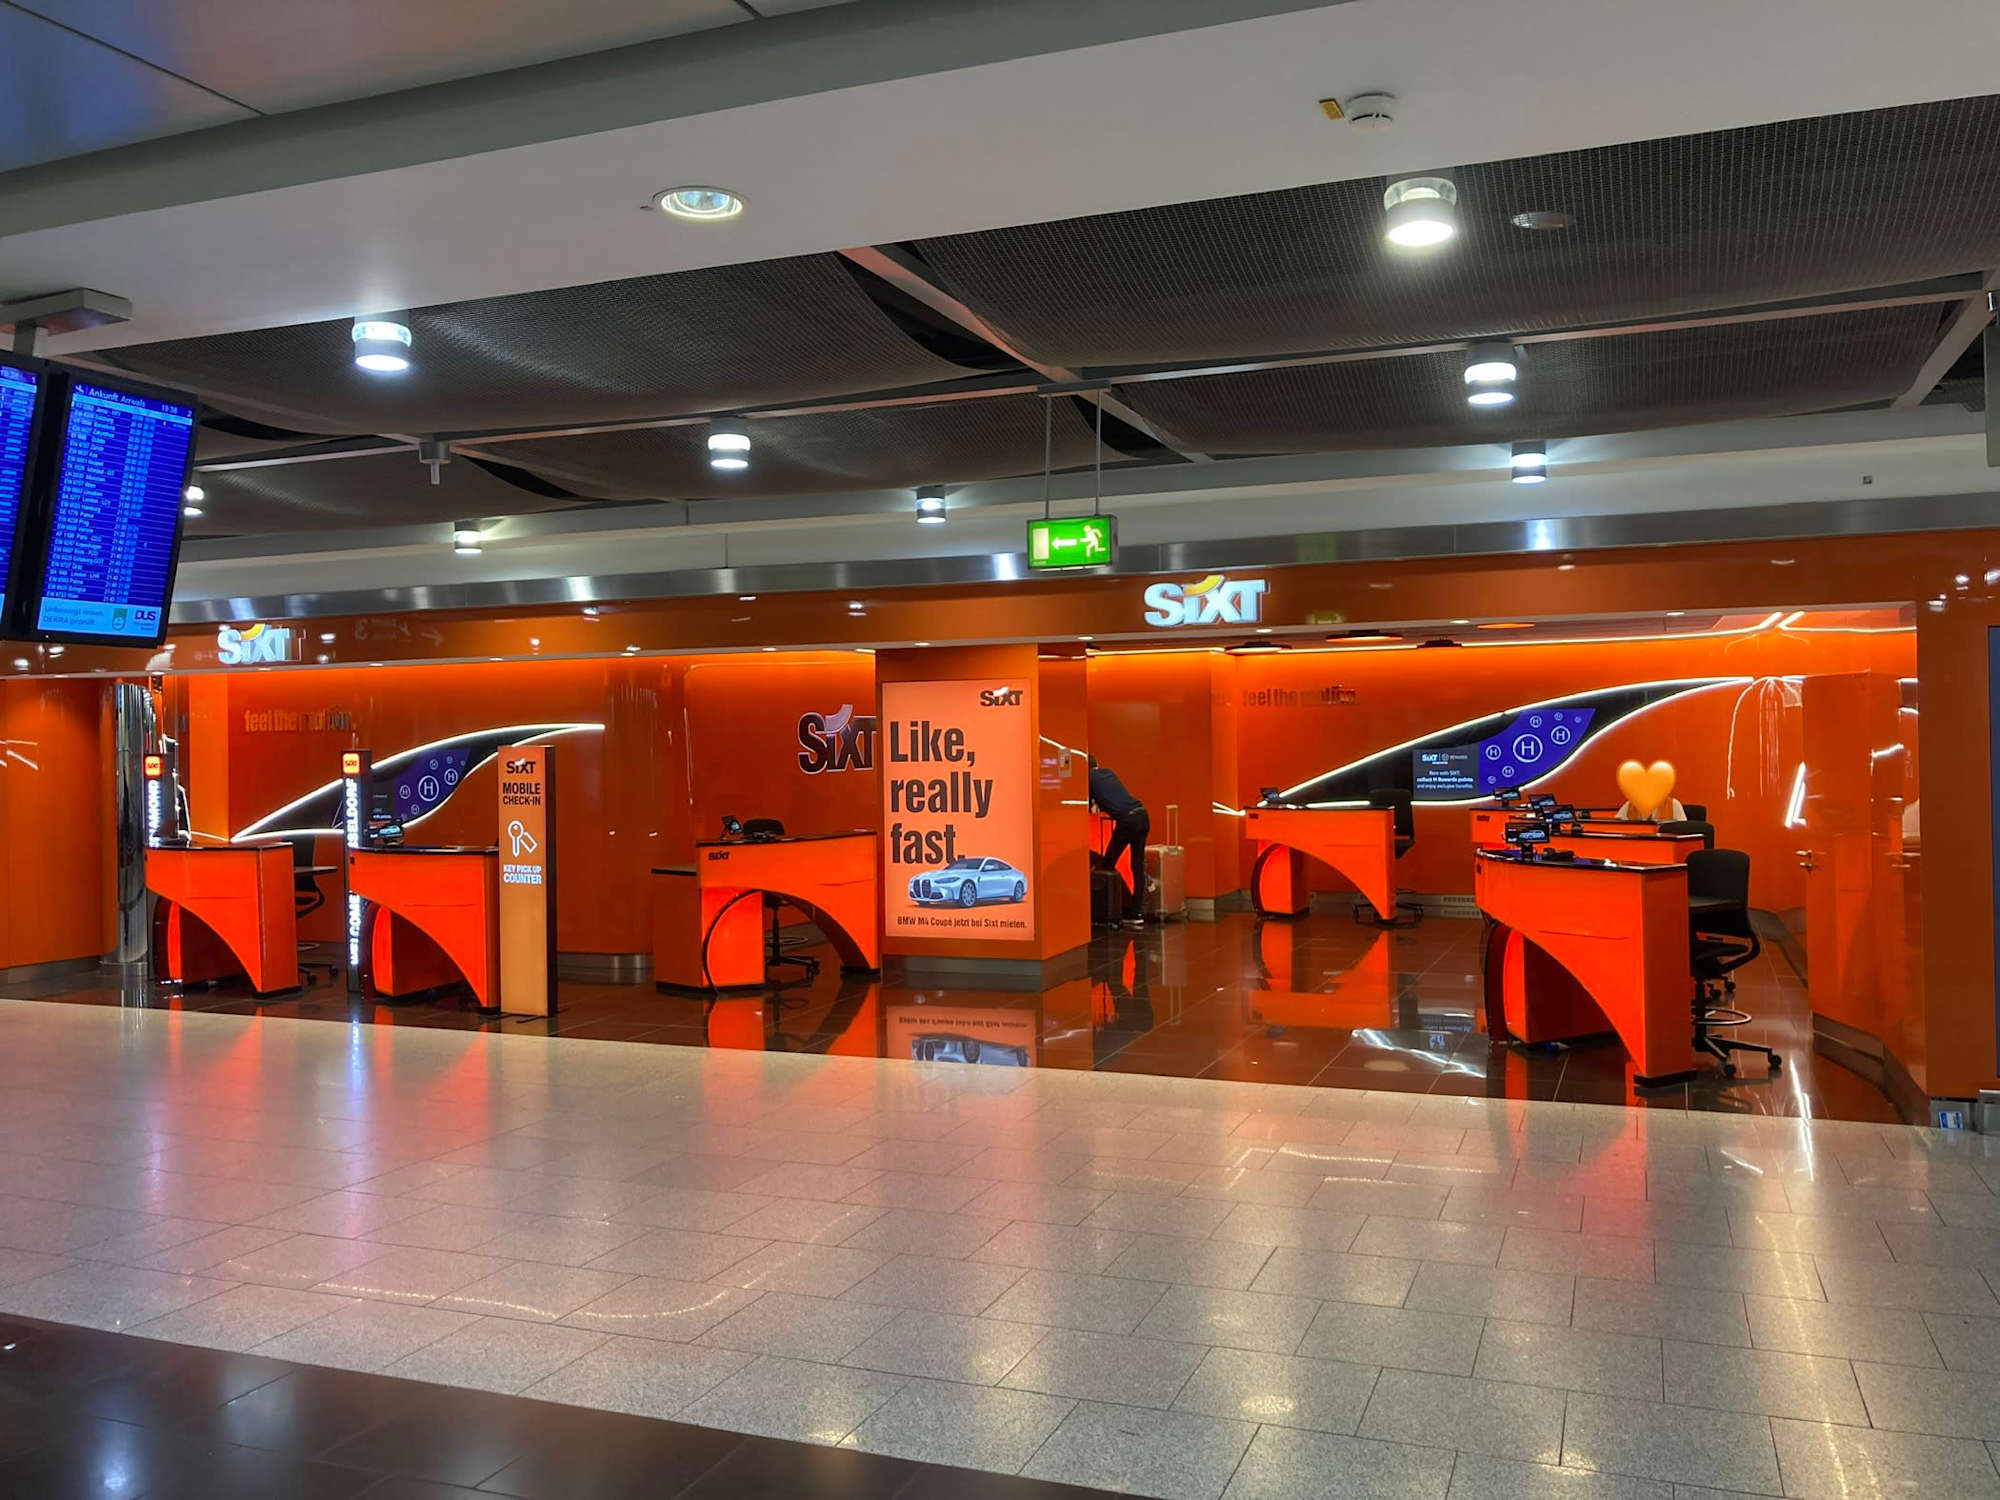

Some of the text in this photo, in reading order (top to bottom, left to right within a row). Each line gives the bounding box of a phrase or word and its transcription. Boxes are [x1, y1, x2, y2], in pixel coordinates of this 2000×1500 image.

[89, 388, 145, 408] Ankunft Arrivals
[135, 609, 157, 621] DUS
[890, 721, 975, 767] Like,
[502, 782, 541, 795] MOBILE
[890, 771, 993, 818] really
[502, 795, 541, 806] CHECK-IN
[890, 823, 966, 865] fast.
[503, 864, 517, 872] KEY
[503, 873, 542, 884] COUNTER
[897, 916, 916, 926] BMW
[917, 917, 929, 926] M4
[971, 918, 983, 928] bei
[984, 918, 999, 929] Sixt
